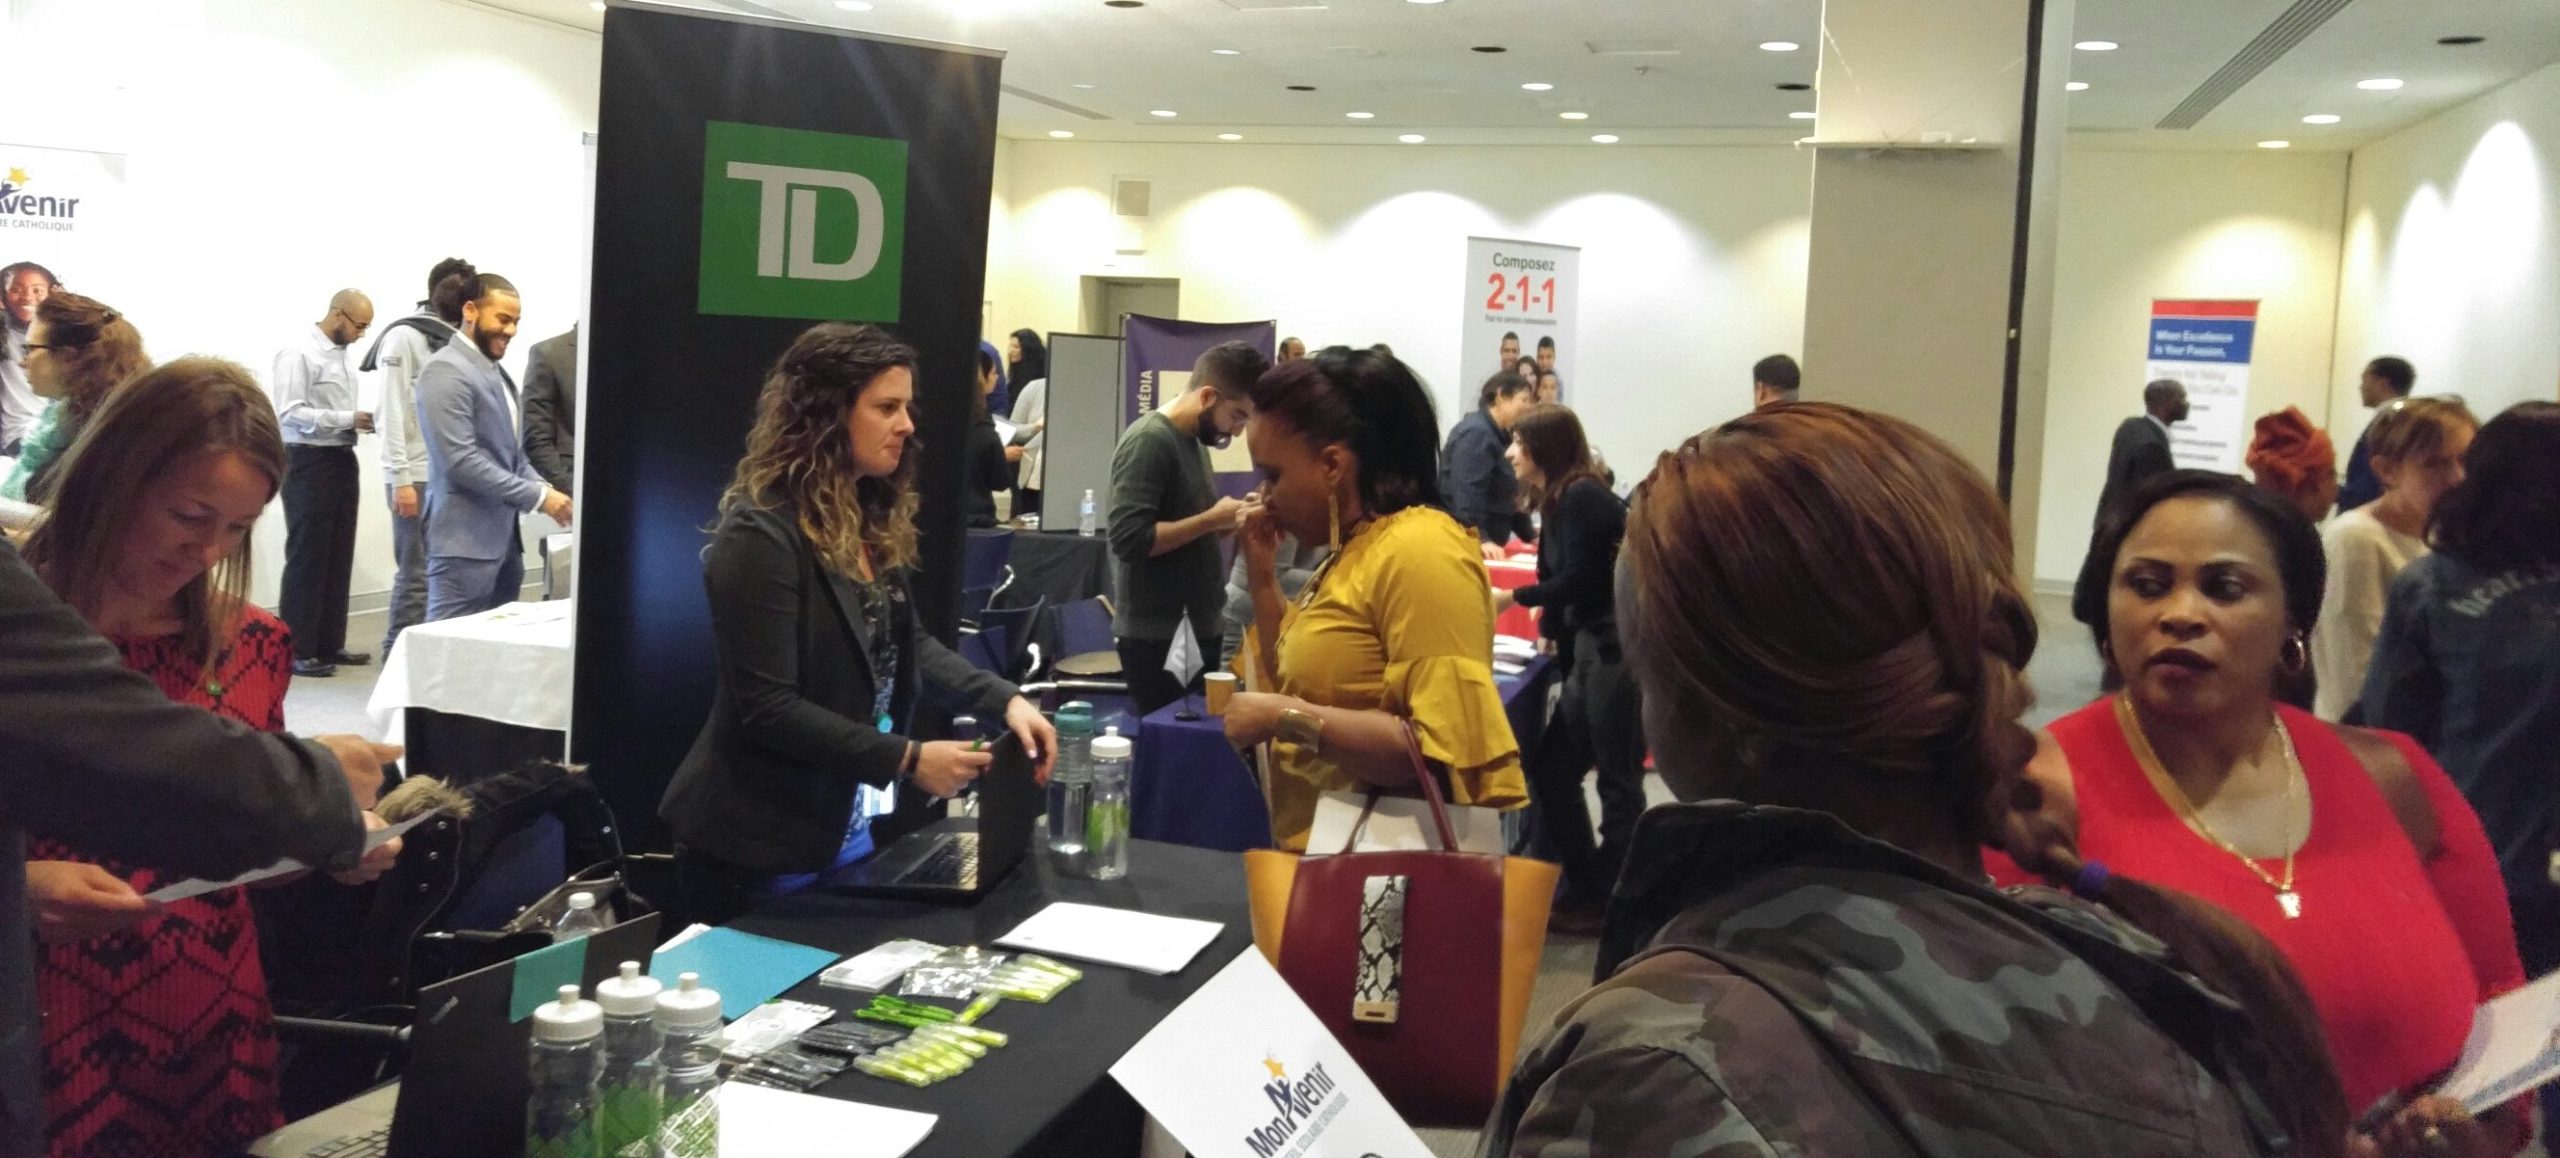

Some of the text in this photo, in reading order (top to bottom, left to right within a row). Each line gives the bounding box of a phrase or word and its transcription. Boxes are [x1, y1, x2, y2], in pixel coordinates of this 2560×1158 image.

[12, 219, 75, 232] CATHOLIQUE
[726, 161, 885, 281] TD
[1493, 252, 1556, 272] Composez
[1486, 272, 1556, 314] 2-1-1
[1245, 1060, 1336, 1158] MonAvenir
